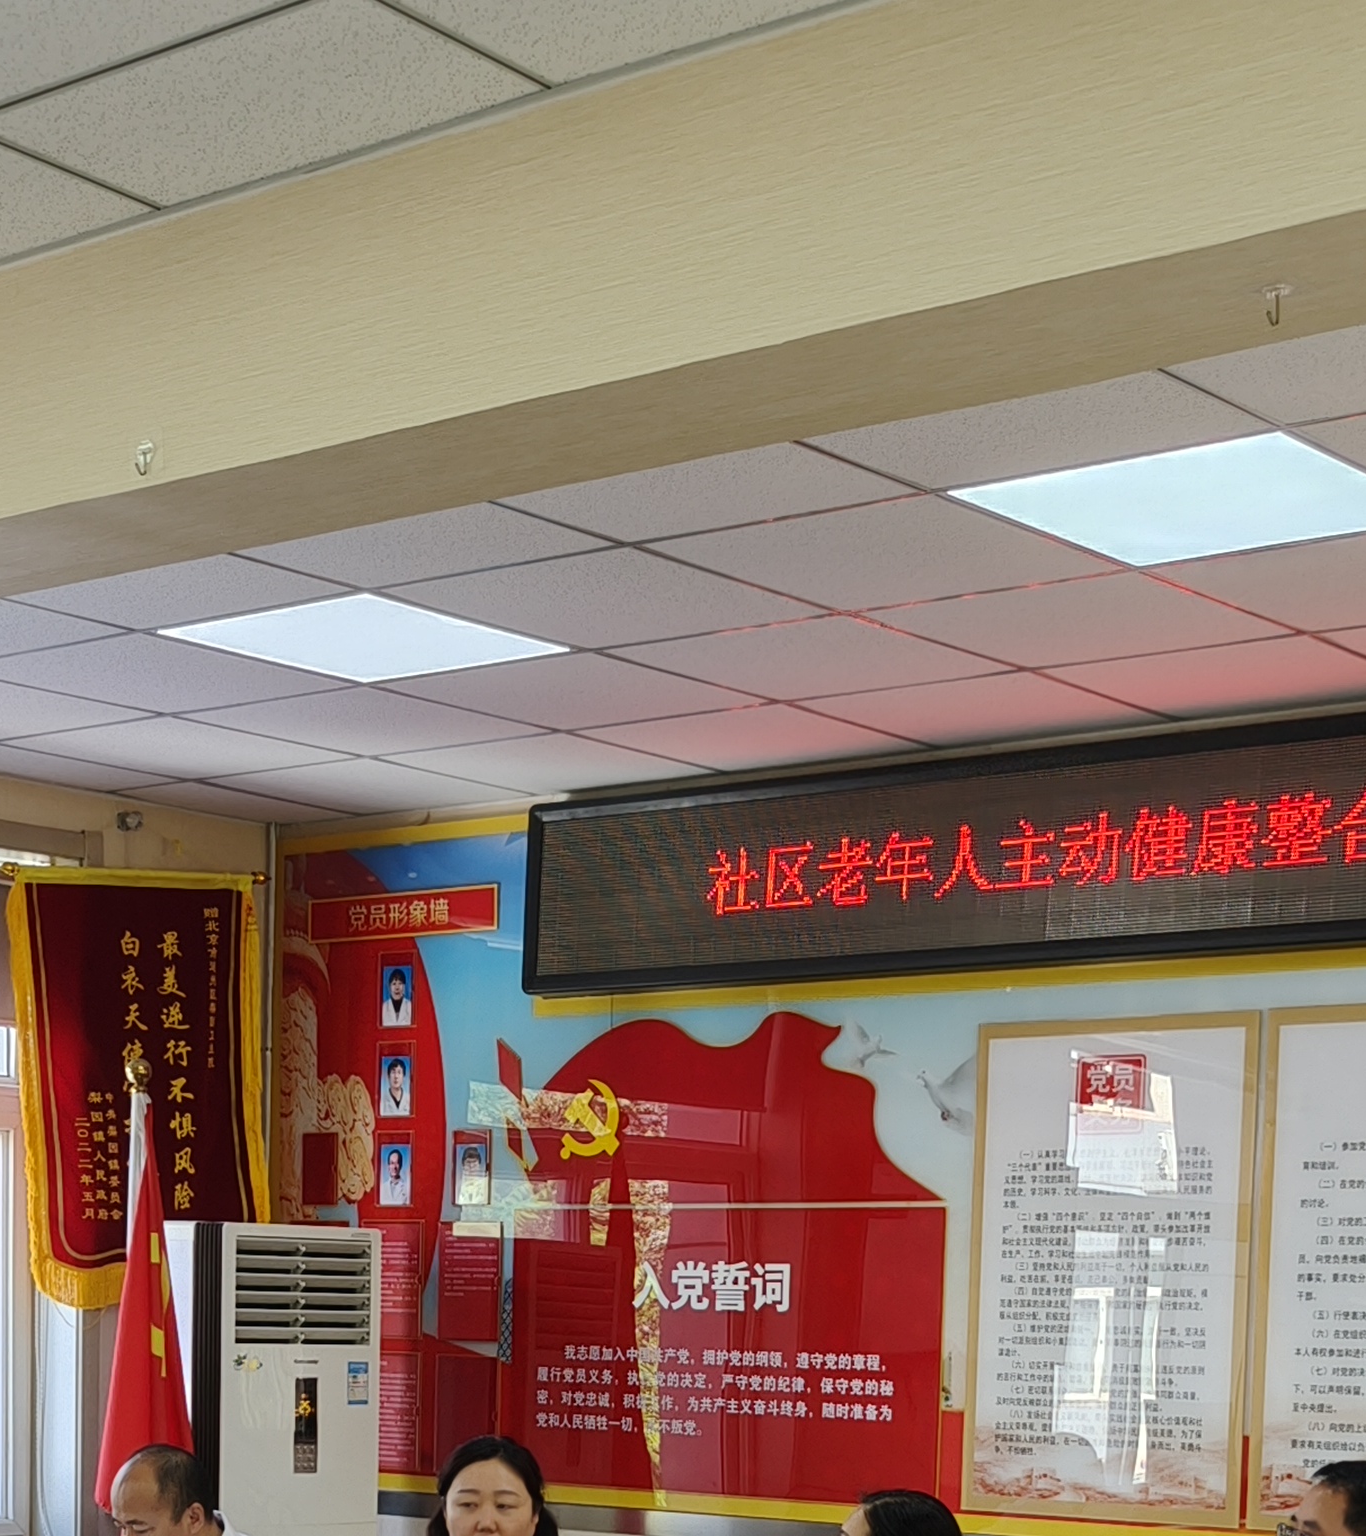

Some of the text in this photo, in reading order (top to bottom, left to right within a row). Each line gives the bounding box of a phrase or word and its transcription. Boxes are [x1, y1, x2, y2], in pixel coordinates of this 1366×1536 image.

[348, 898, 450, 932] 党员形象墙
[1086, 1061, 1135, 1093] 党员
[632, 1261, 791, 1312] 入党誓词
[536, 1367, 895, 1396] 履行党员义务，执党的决定，严守党的纪律，保守党的秘
